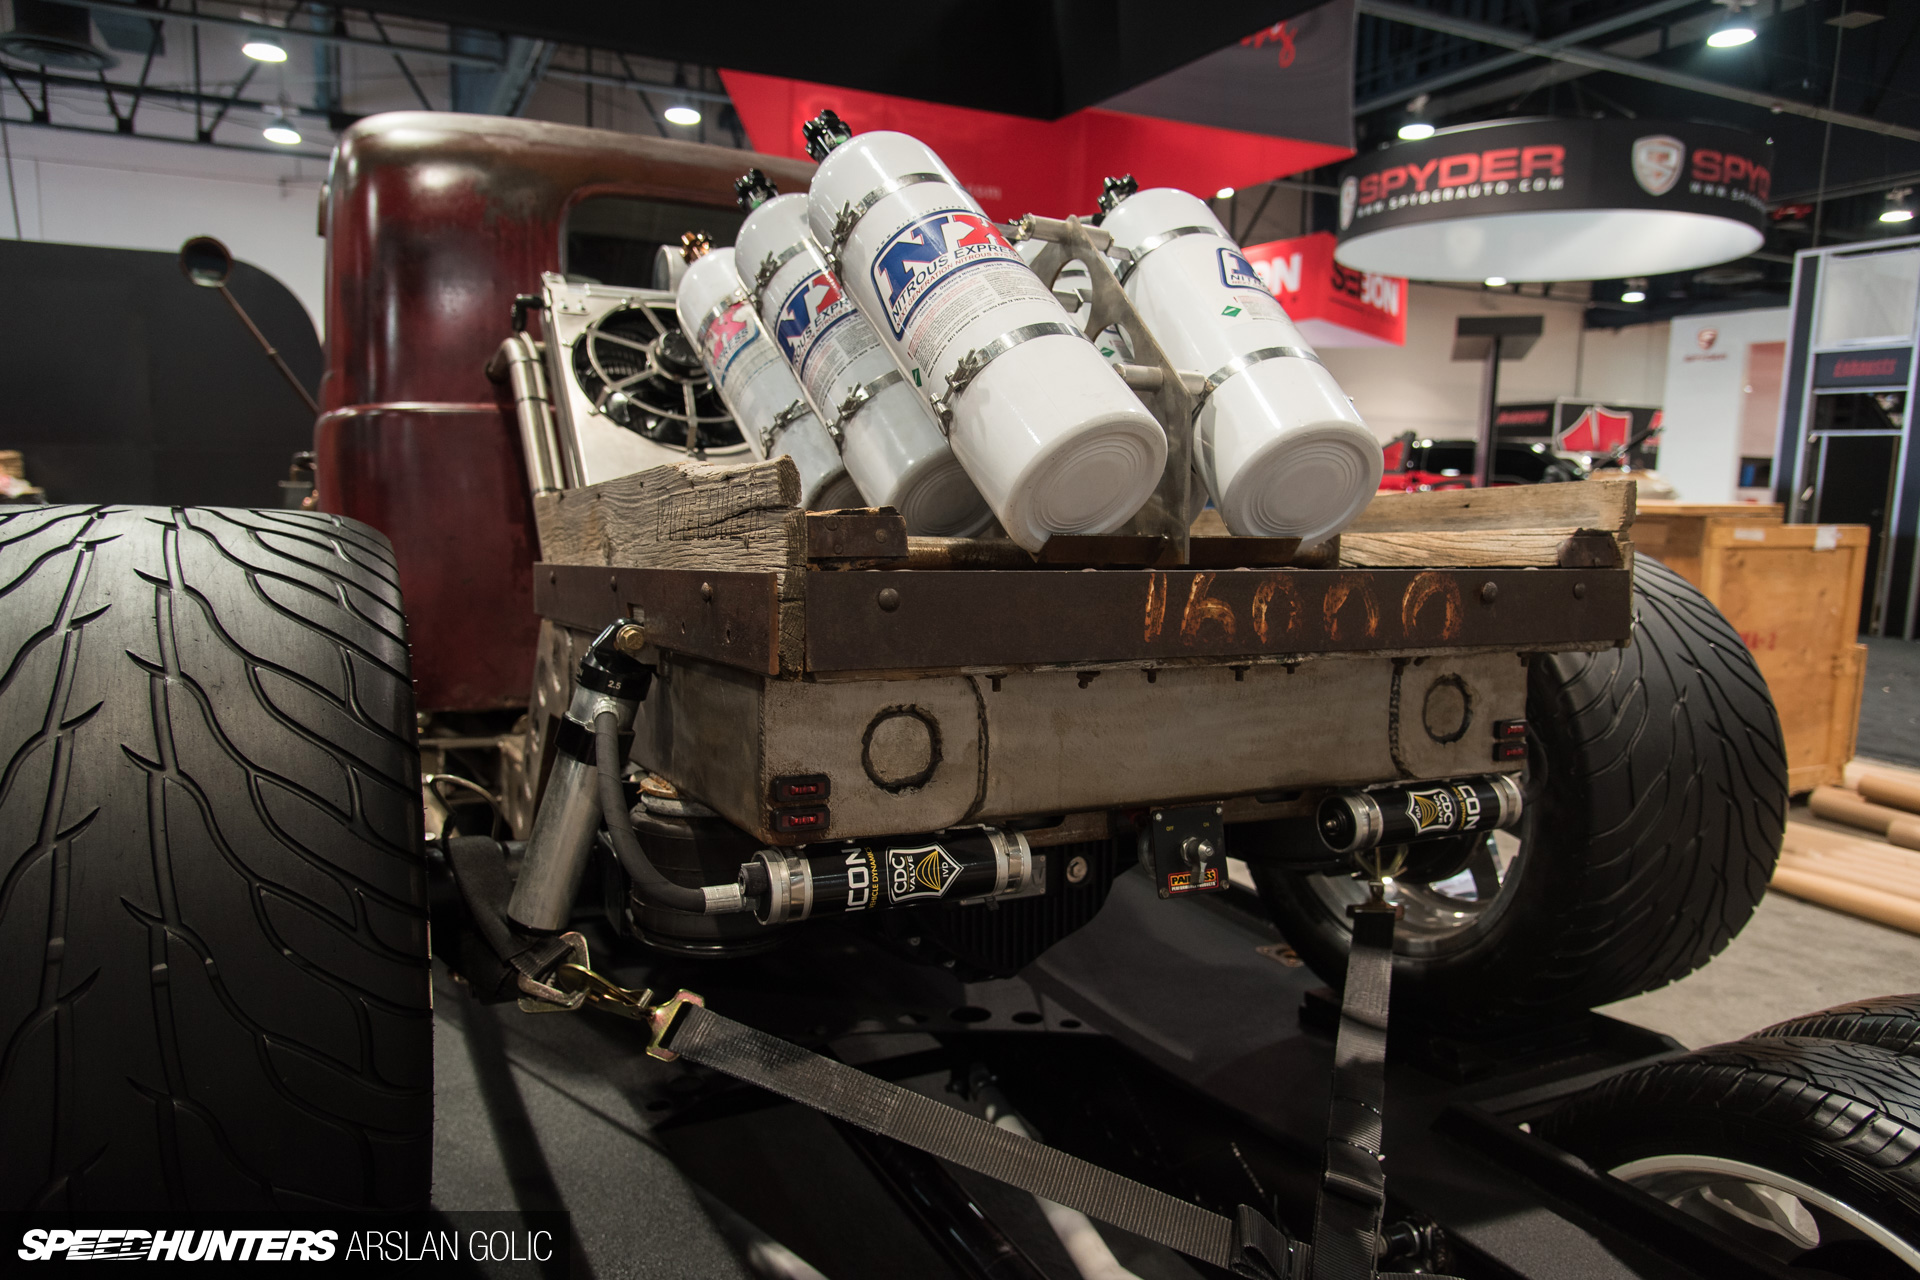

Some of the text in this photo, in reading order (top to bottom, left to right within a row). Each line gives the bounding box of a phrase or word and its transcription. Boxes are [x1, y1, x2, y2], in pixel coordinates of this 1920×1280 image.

[1358, 144, 1566, 206] SPYDER
[877, 214, 1016, 310] NX
[892, 255, 948, 323] NITROUS
[954, 244, 1017, 259] EXPRES
[908, 264, 953, 306] GENERATION
[955, 252, 992, 264] NITROUS
[1433, 794, 1443, 823] VALVE
[1439, 793, 1453, 823] CDC
[841, 848, 869, 912] ICON
[865, 847, 879, 908] VEHICLE DYNAMICS
[892, 856, 908, 894] CDC
[907, 855, 916, 892] VALVE
[941, 861, 949, 877] IVD
